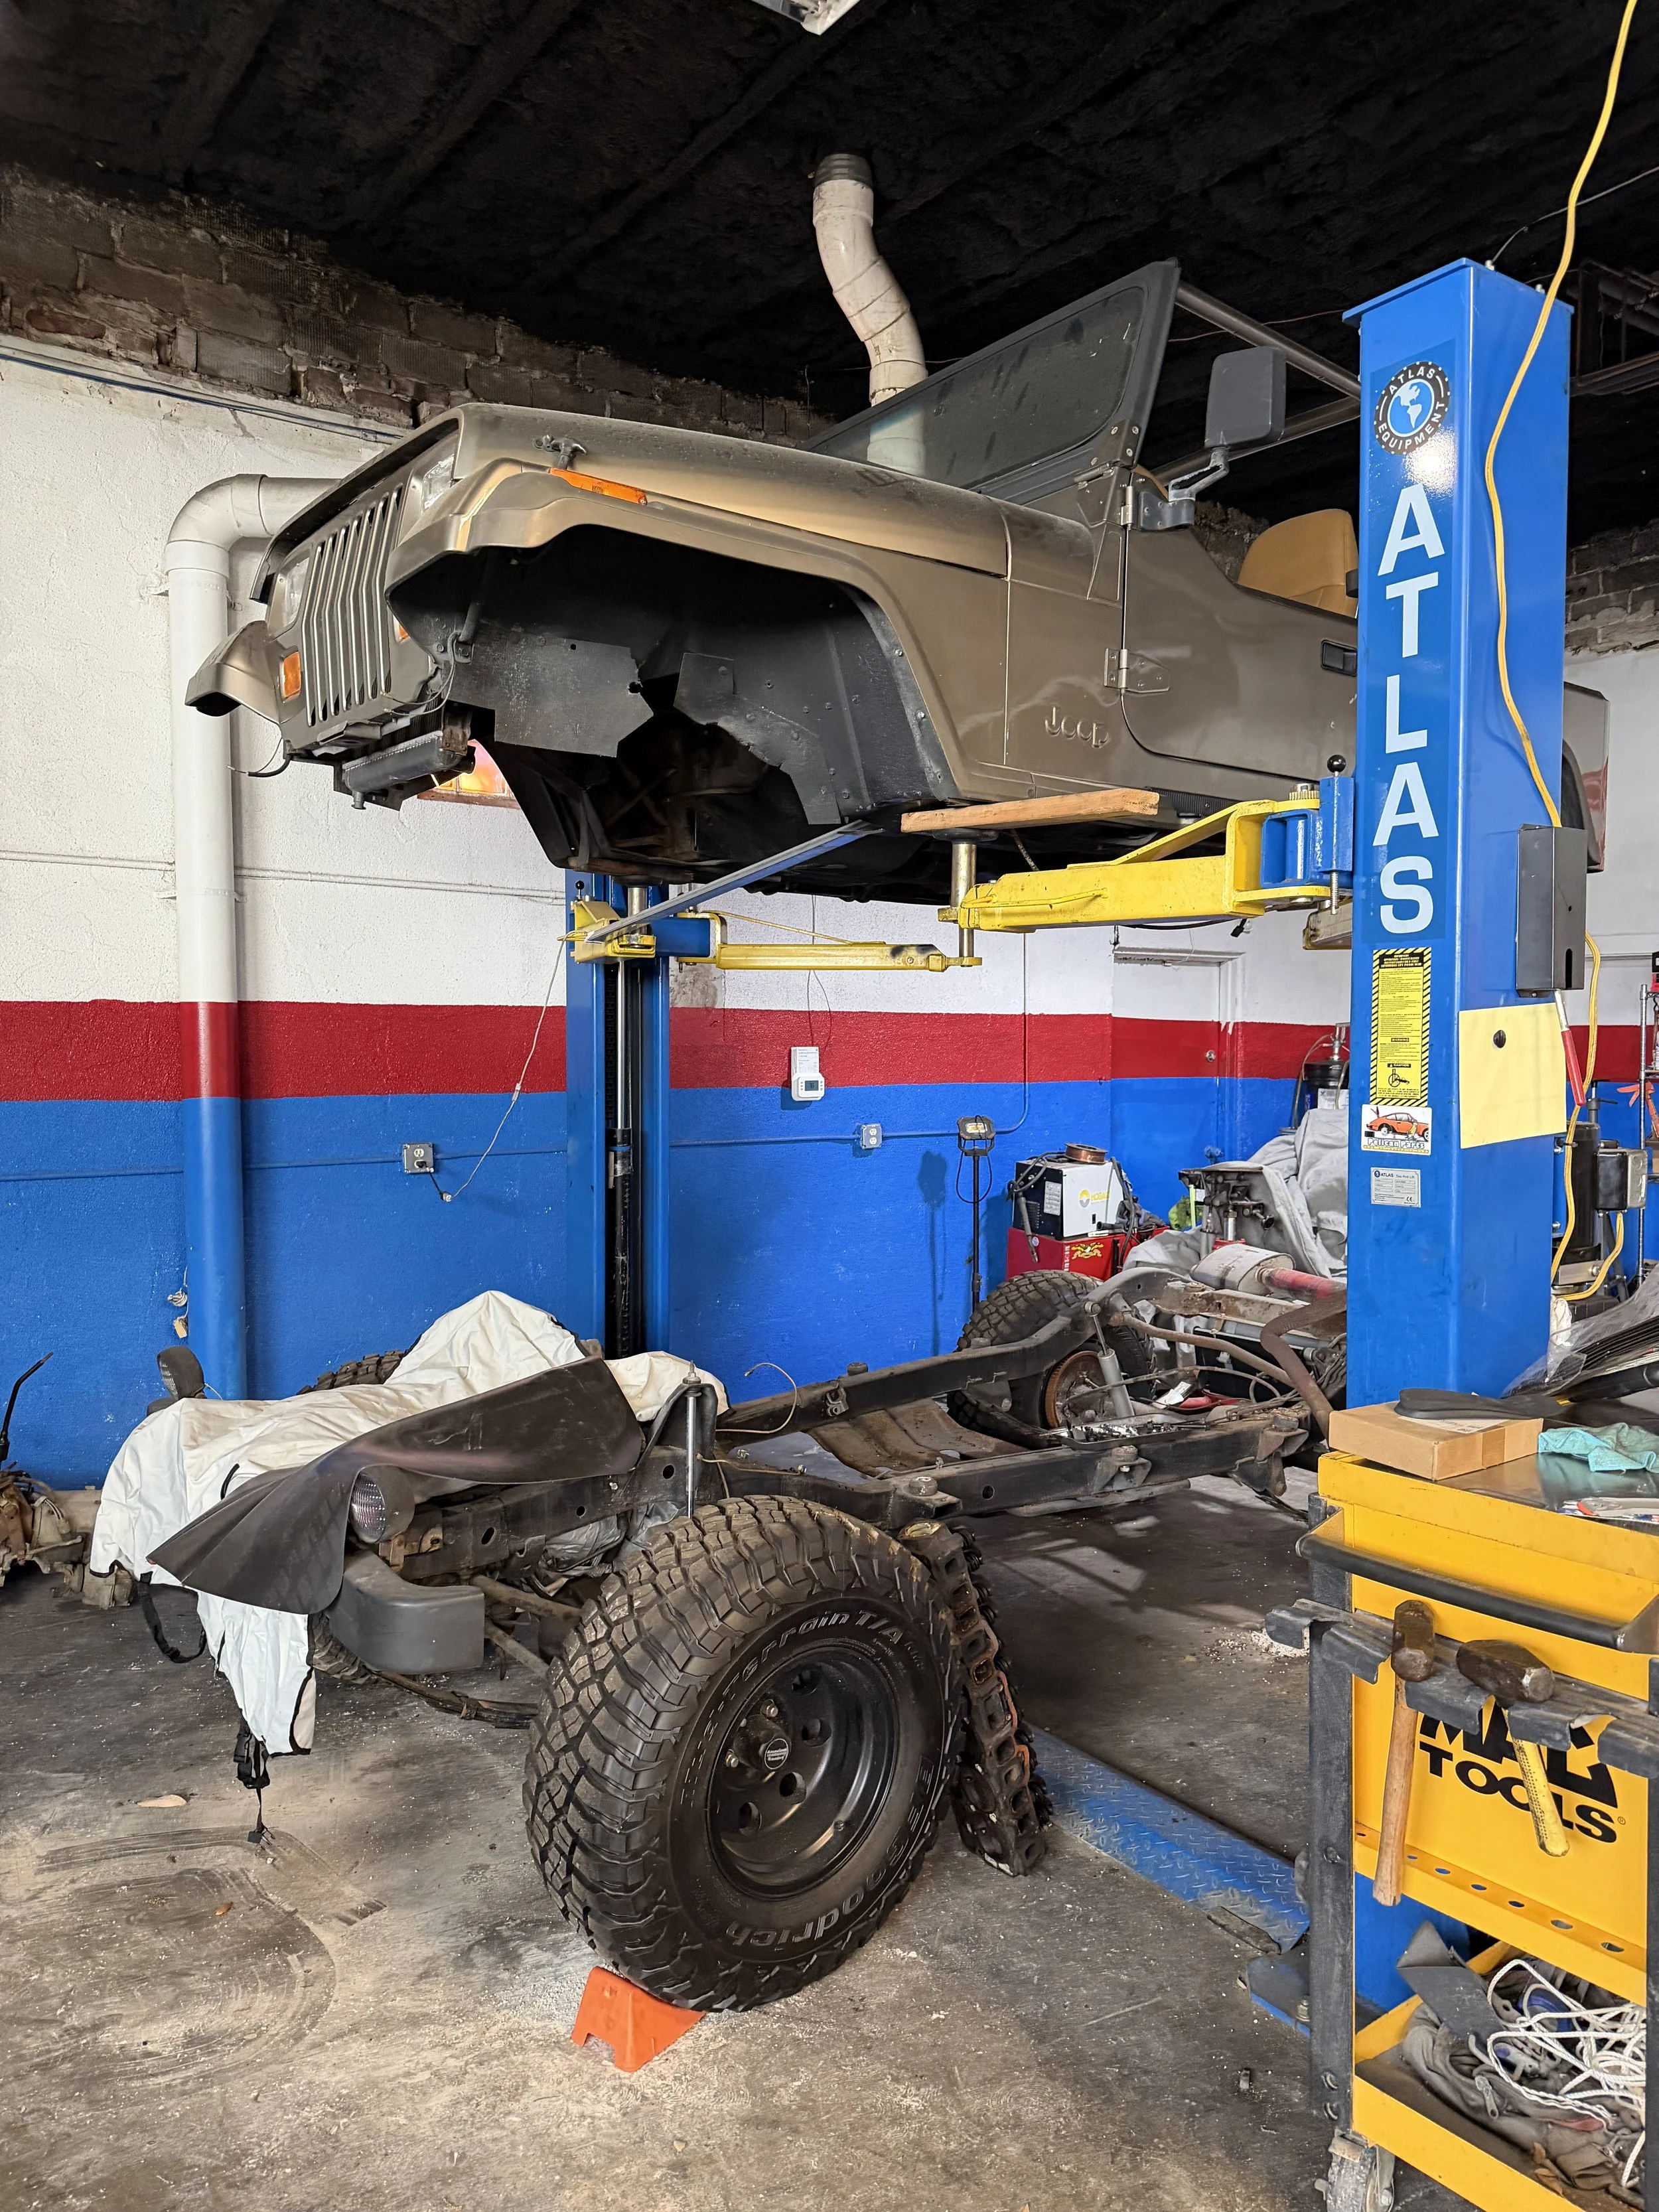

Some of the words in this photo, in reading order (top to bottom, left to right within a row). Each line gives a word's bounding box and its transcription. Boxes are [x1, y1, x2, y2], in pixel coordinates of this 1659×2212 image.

[1389, 366, 1436, 395] ATLAS
[1378, 402, 1445, 450] EQUIPMENT
[1372, 482, 1445, 934] ATLAS
[1368, 1138, 1399, 1147] Pelican
[855, 1609, 904, 1645] T/A
[1419, 1739, 1618, 1844] TOOLS
